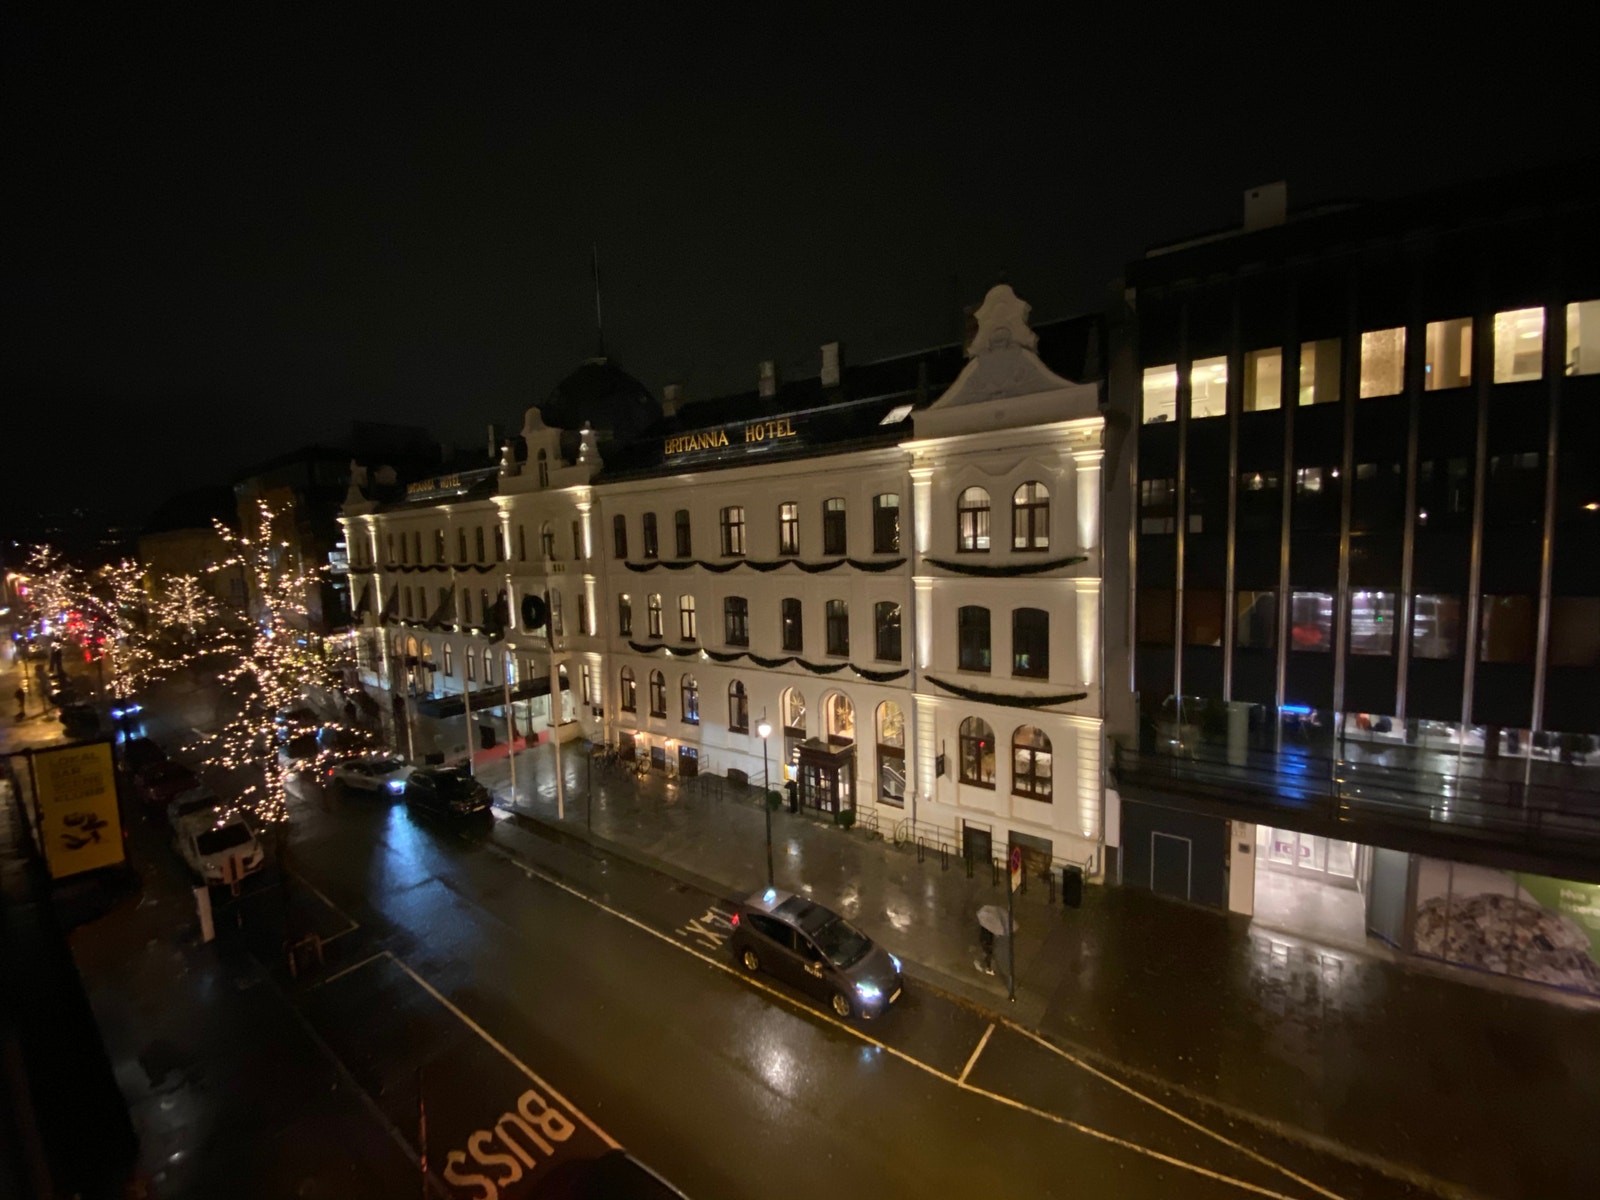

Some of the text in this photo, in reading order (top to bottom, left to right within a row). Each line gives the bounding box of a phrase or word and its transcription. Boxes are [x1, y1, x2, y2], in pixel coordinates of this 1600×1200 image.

[664, 418, 797, 454] BRITANNIA HOTEL
[443, 1089, 576, 1200] BUSS
